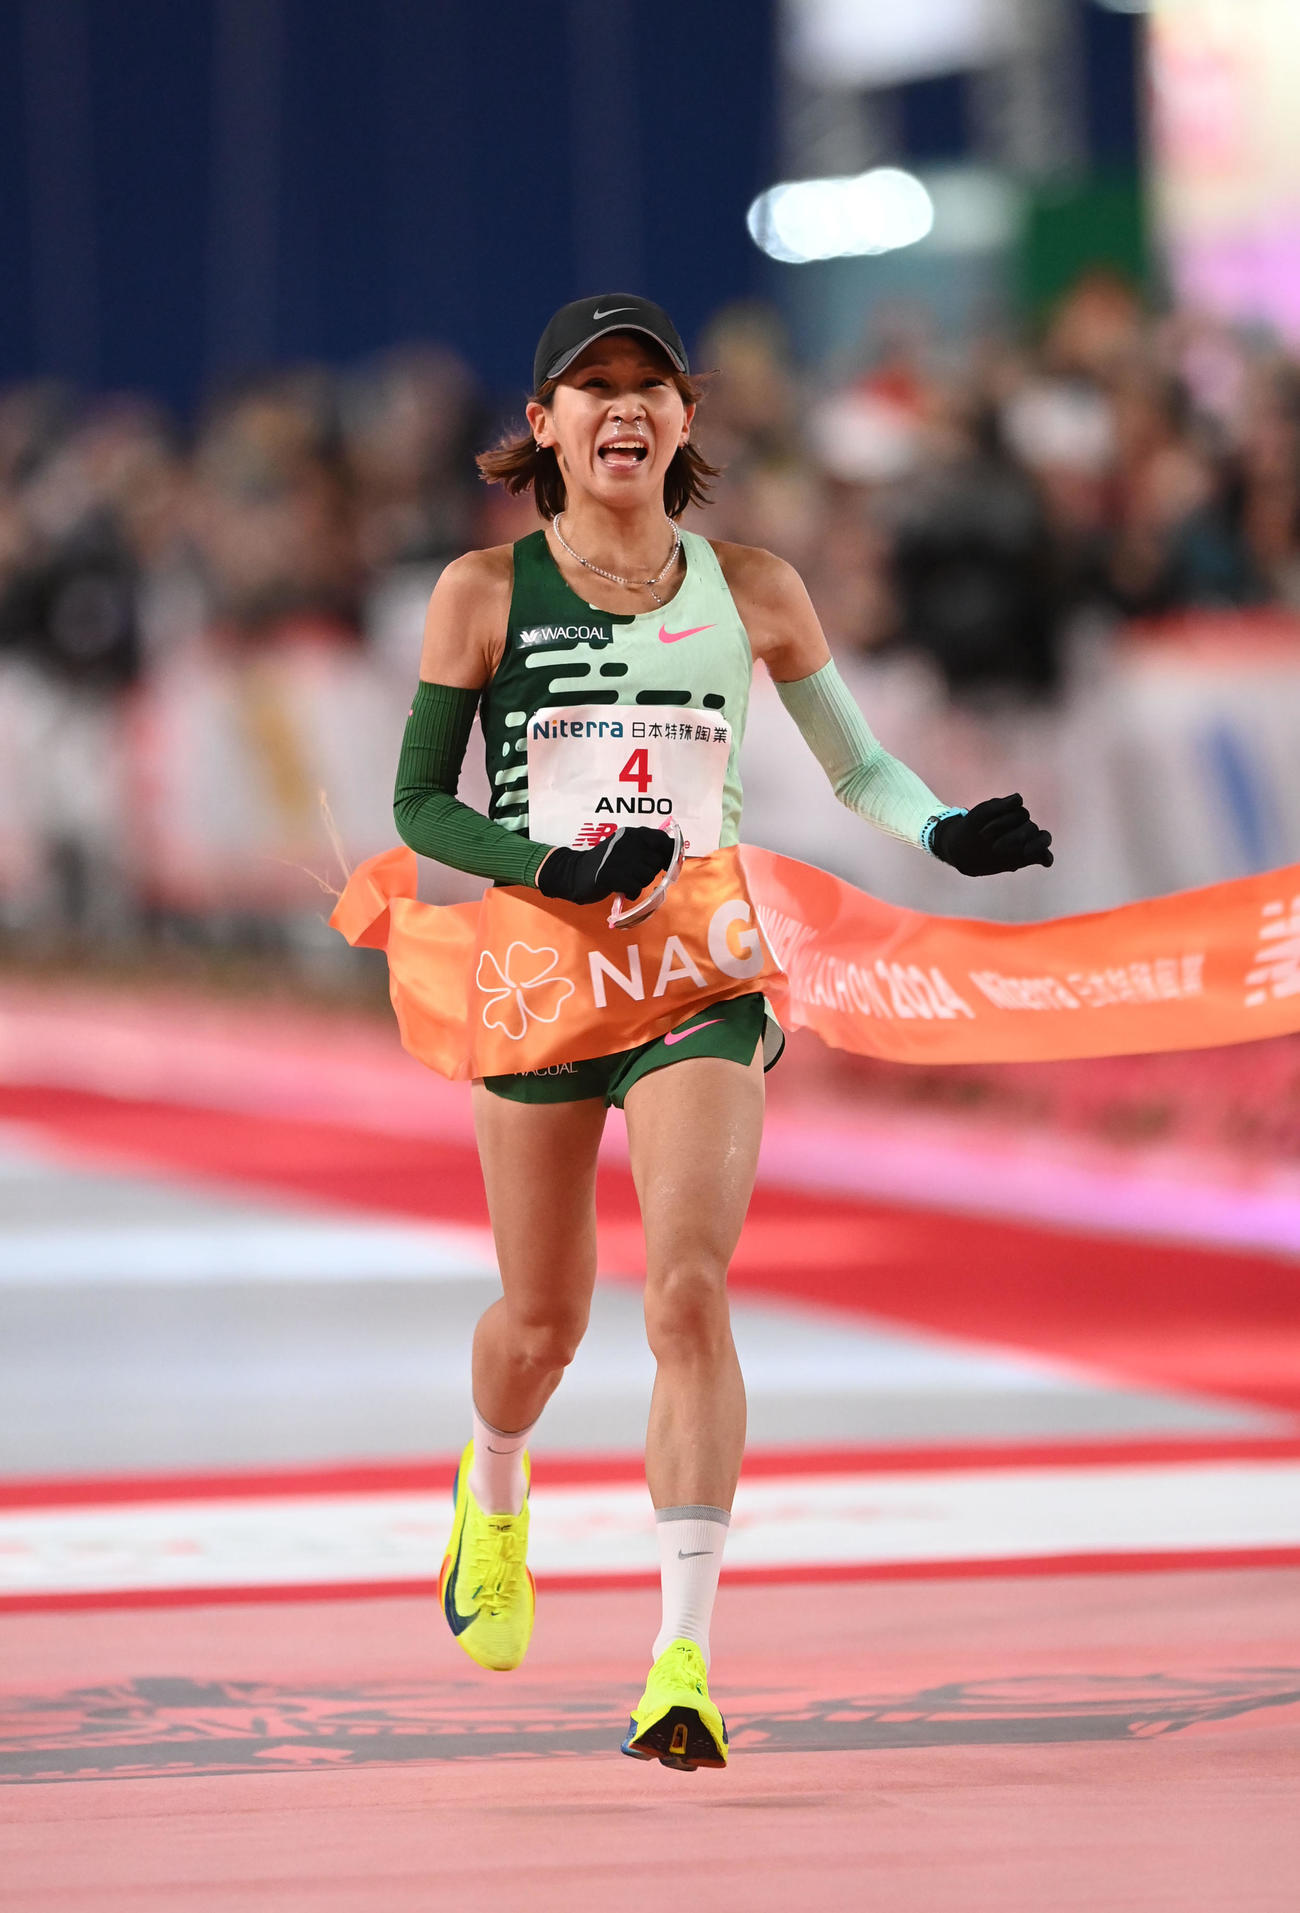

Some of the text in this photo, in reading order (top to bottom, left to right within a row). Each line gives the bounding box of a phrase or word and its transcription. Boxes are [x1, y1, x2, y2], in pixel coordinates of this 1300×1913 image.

[541, 625, 610, 641] WACOAL
[532, 719, 729, 744] Niterra 日本特殊陶業
[618, 748, 653, 793] 4
[594, 796, 673, 815] ANDO
[587, 899, 765, 1009] NAG
[873, 958, 977, 1021] 2024
